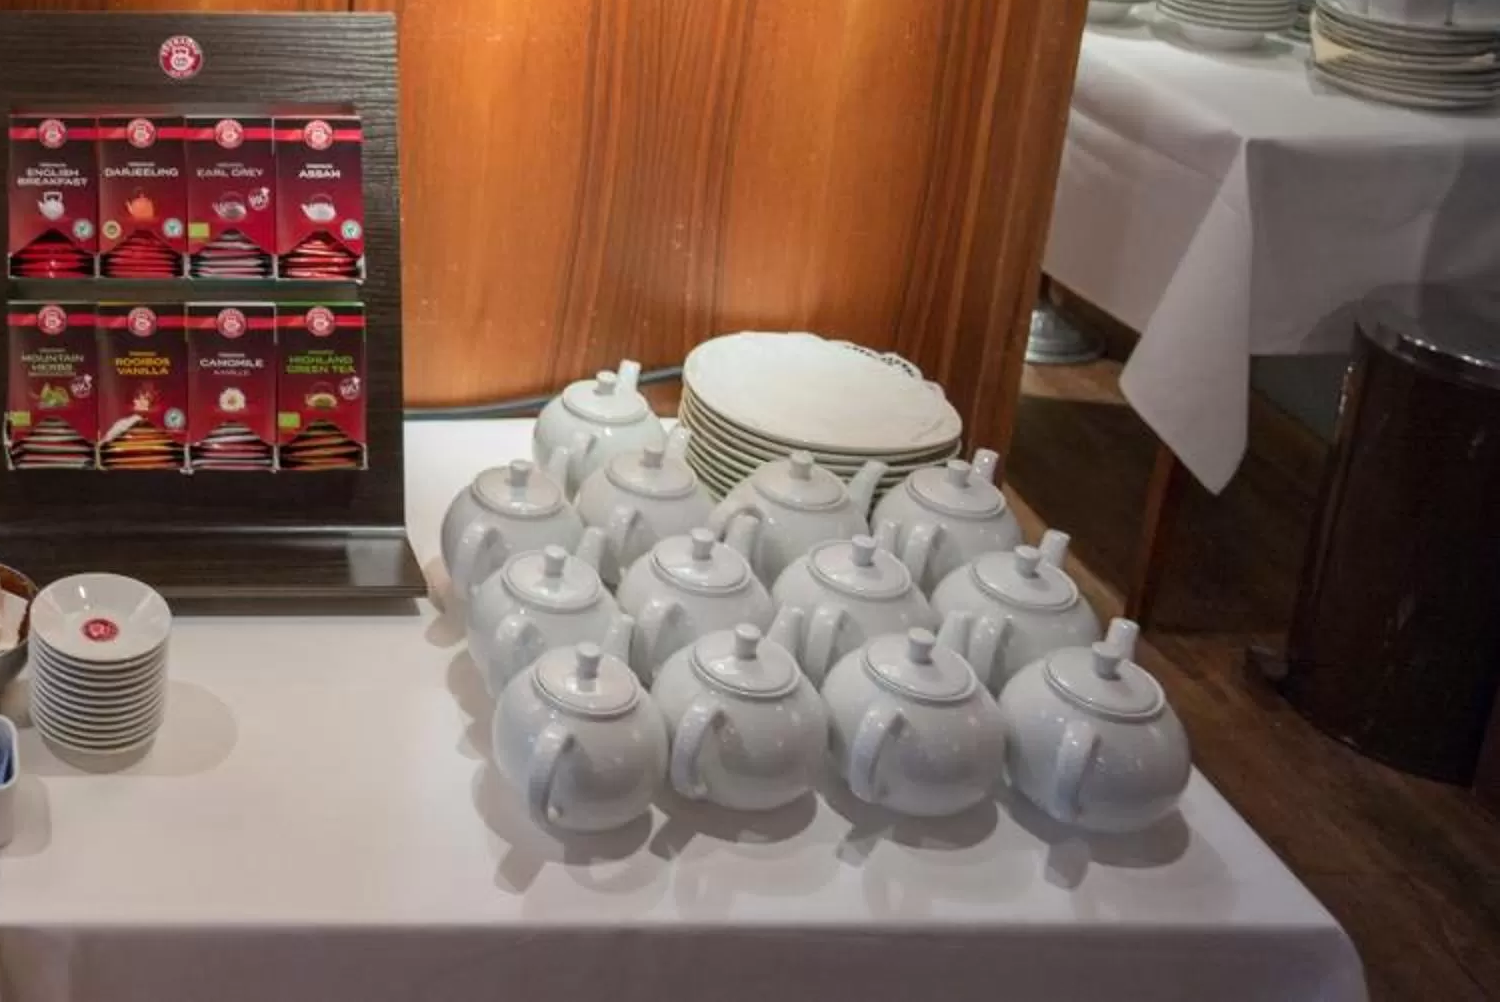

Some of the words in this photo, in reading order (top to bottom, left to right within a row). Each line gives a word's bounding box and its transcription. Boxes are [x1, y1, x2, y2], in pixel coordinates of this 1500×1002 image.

[27, 167, 80, 177] ENGLISH
[104, 166, 179, 177] DARJEELING
[196, 167, 229, 178] EARL
[231, 167, 264, 177] GREY
[298, 169, 341, 179] ASSAM
[16, 176, 88, 188] BREAKFAST
[21, 353, 85, 363] MOUNTAIN
[115, 357, 170, 367] ROOIBOS
[199, 358, 264, 368] CAMOMILE
[289, 356, 353, 365] HIGHLAND
[116, 366, 169, 376] VANILLA
